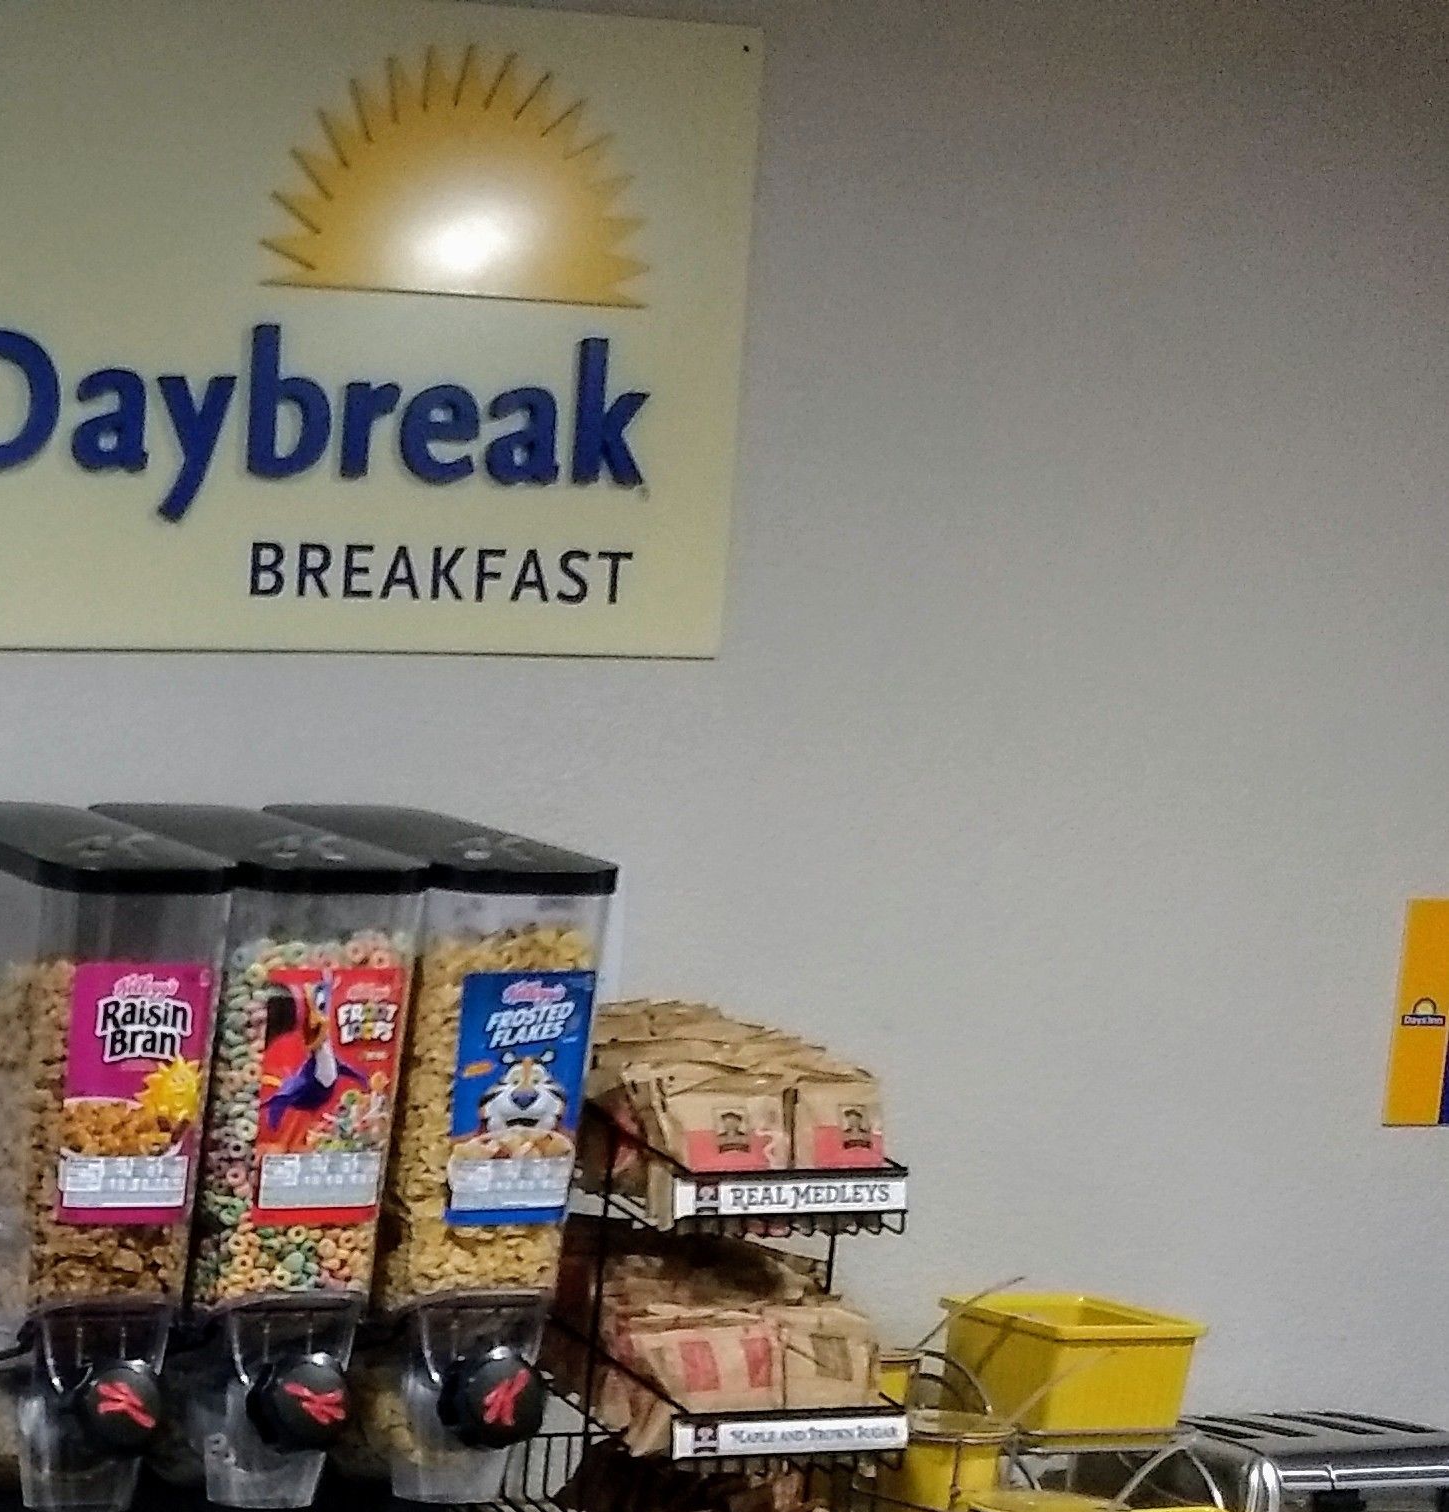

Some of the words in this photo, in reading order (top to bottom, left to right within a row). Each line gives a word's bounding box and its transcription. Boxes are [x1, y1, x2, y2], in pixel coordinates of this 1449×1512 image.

[250, 540, 633, 606] BREAKFAST
[100, 1000, 188, 1032] Raisin
[485, 1001, 576, 1032] FROSTED
[108, 1029, 176, 1057] Bran
[489, 1020, 566, 1049] FLAKES
[730, 1186, 788, 1211] REAL
[790, 1184, 890, 1209] MEDLEYS
